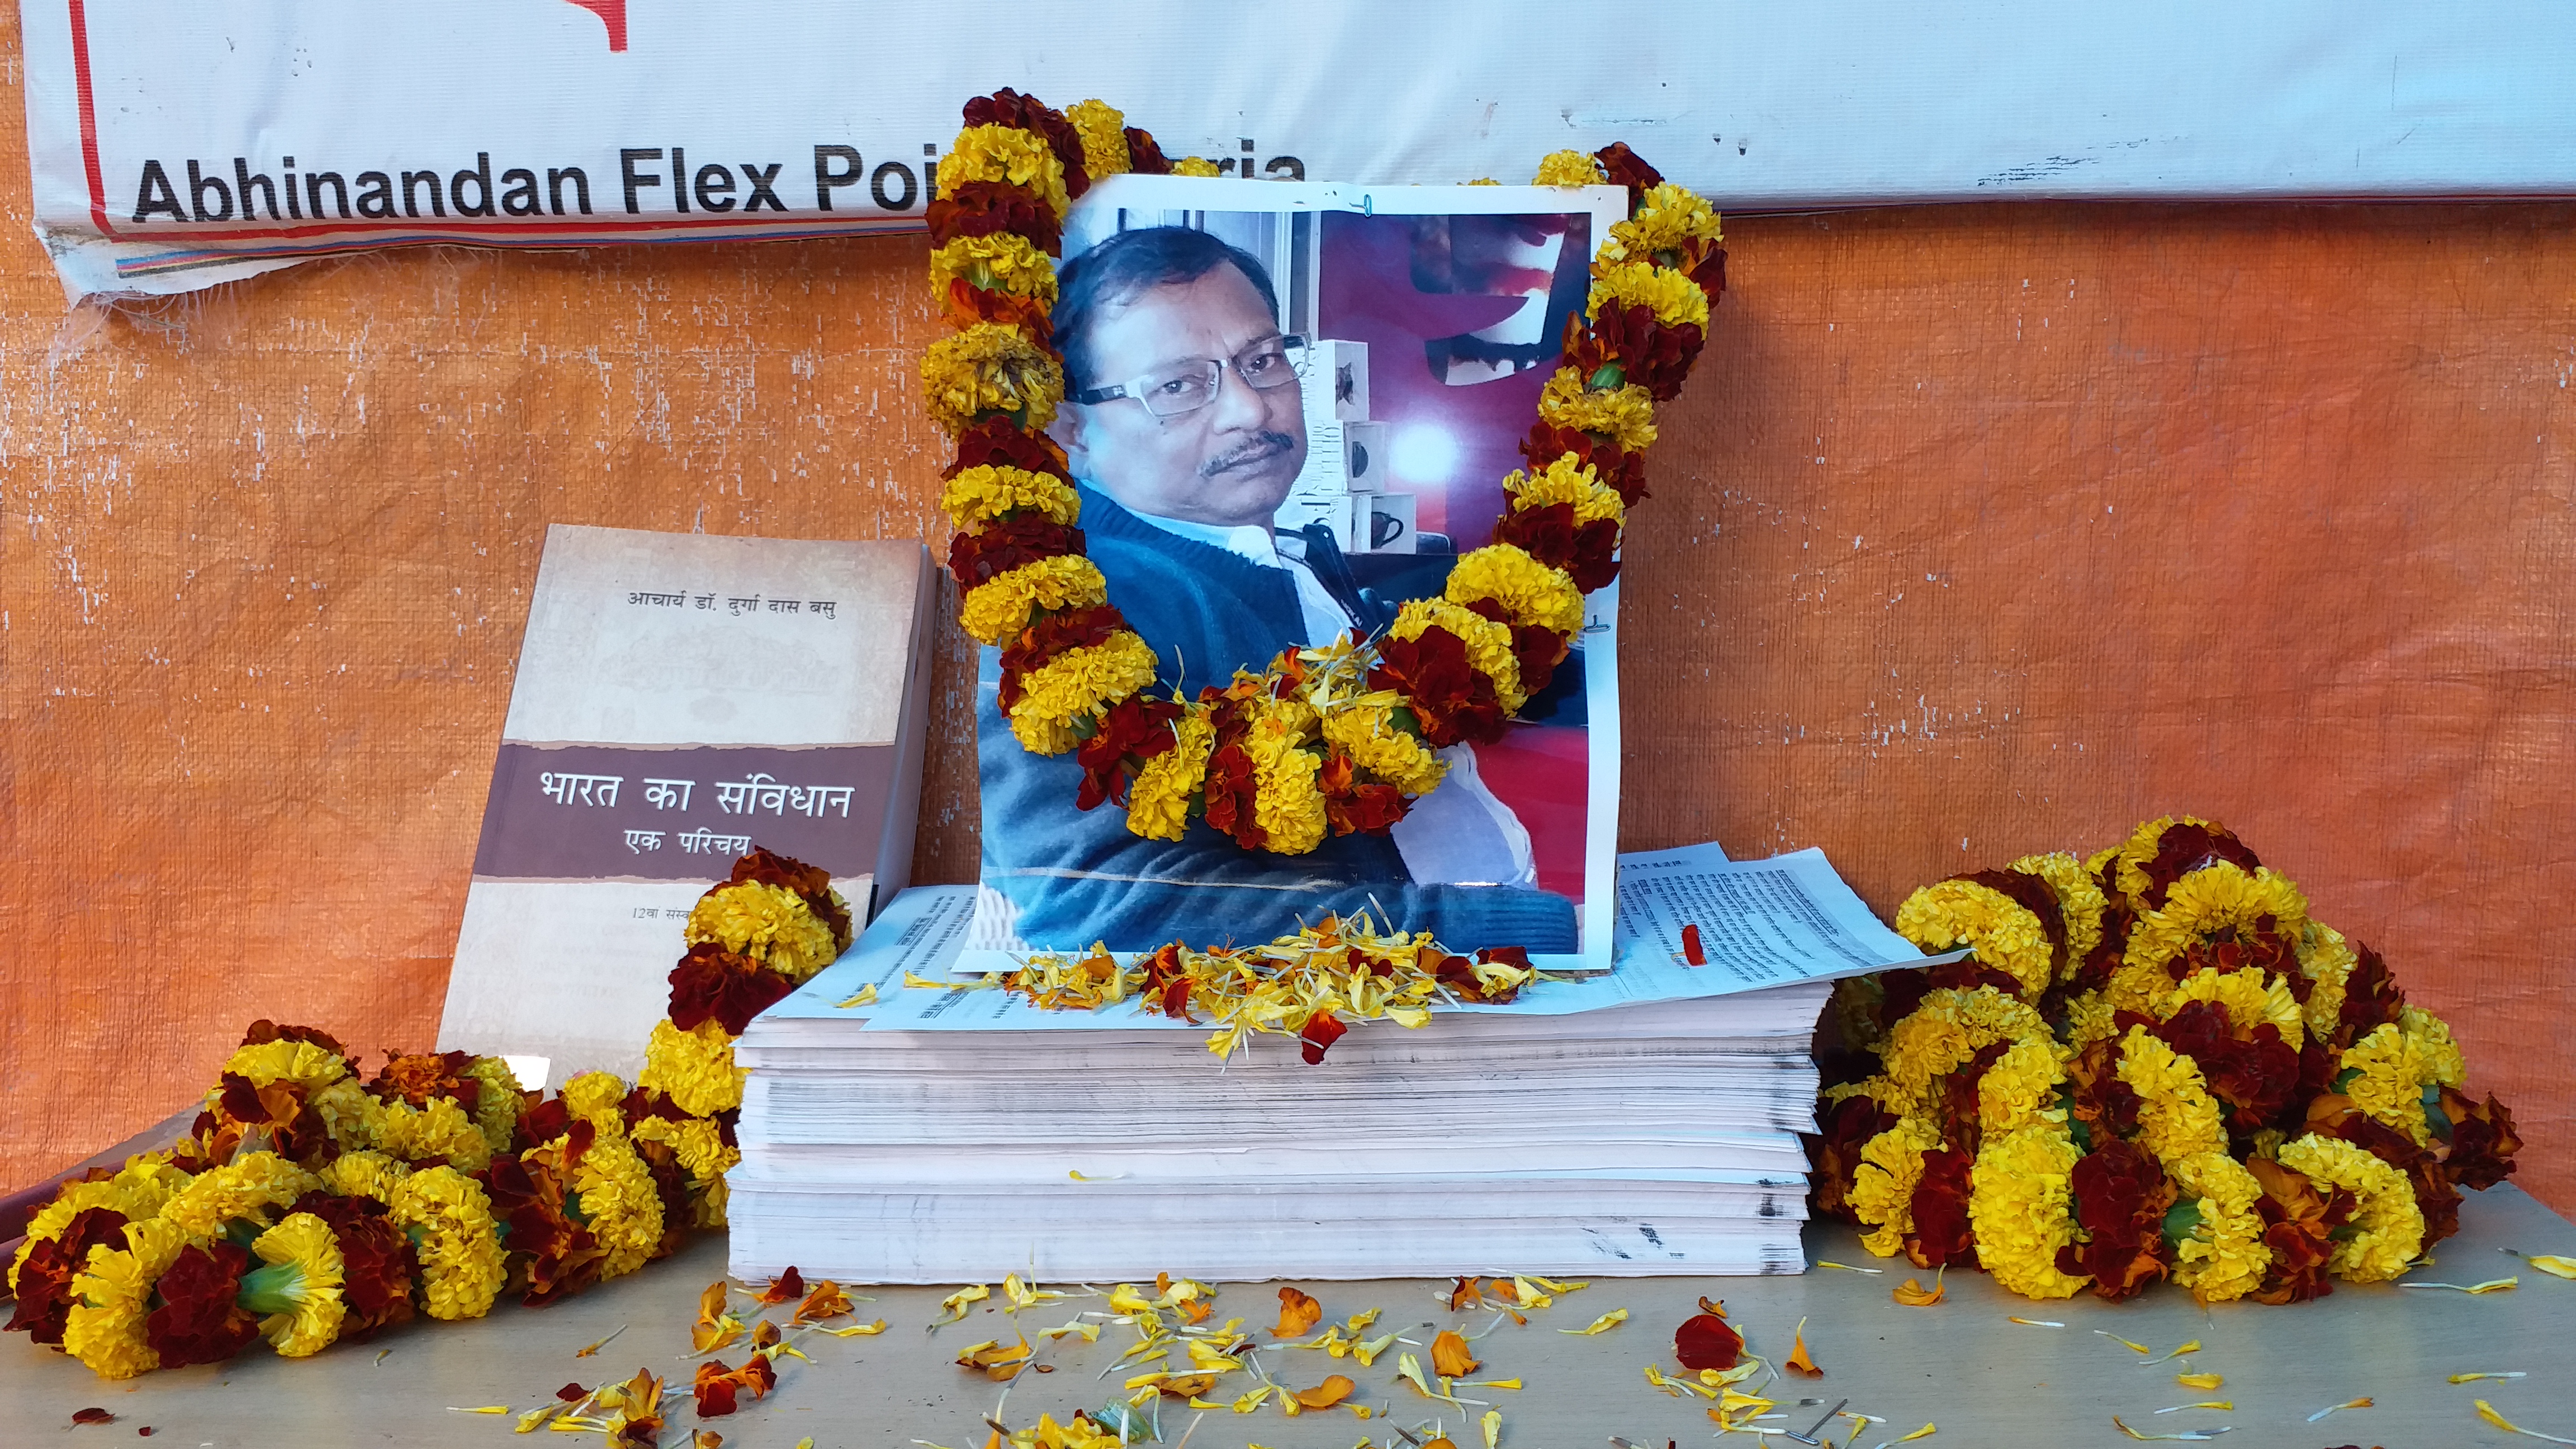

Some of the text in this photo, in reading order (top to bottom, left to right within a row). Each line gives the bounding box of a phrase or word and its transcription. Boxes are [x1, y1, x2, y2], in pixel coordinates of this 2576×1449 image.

[132, 151, 594, 223] Abhinandan
[619, 146, 789, 214] Flex
[814, 143, 937, 211] Poi
[628, 590, 837, 619] आचार्य डॉ. दुर्गा दास बसु
[540, 771, 855, 818] भारत का संविधान
[623, 826, 752, 856] एक परिचय
